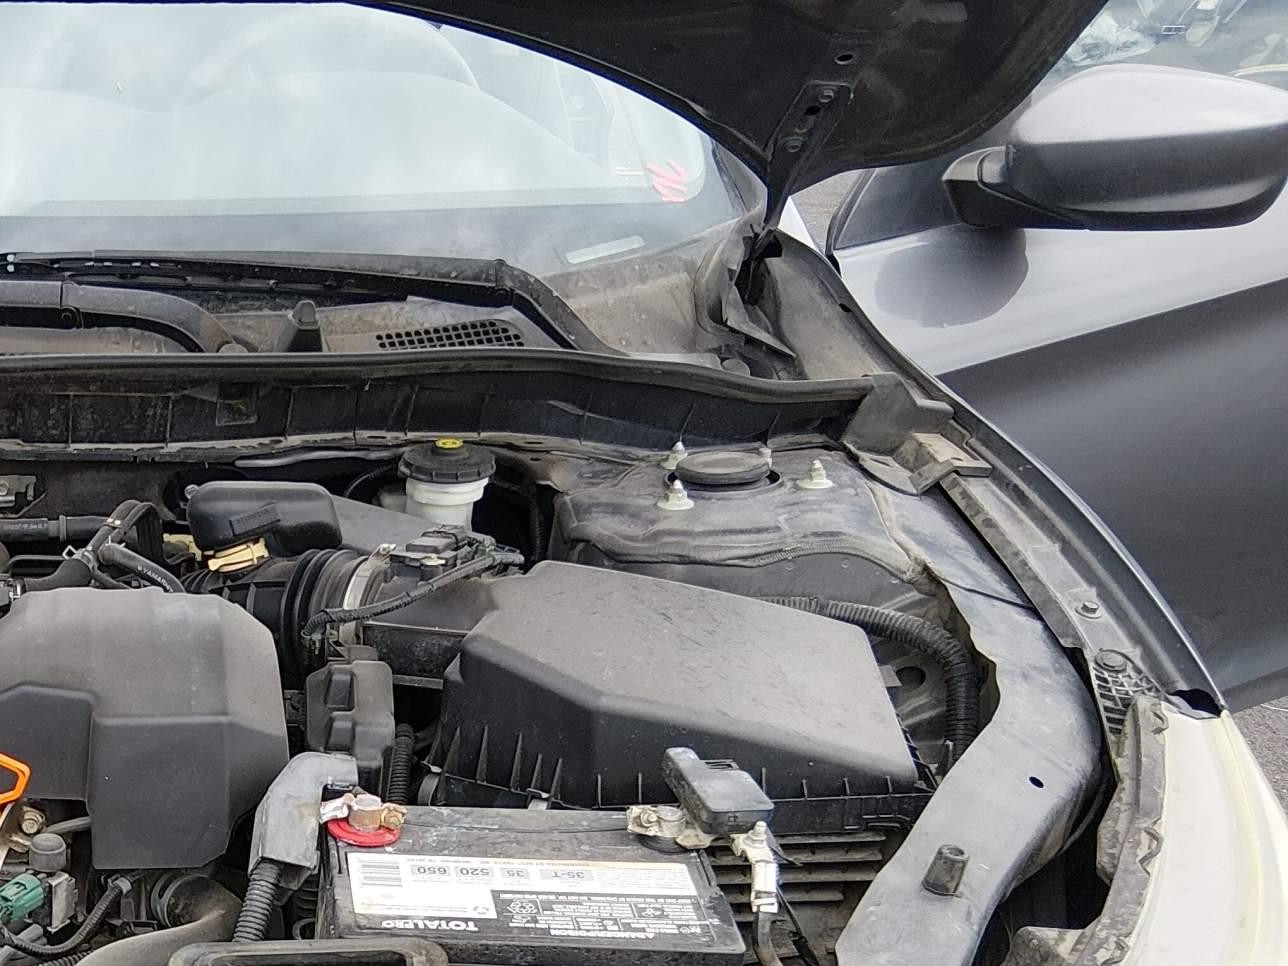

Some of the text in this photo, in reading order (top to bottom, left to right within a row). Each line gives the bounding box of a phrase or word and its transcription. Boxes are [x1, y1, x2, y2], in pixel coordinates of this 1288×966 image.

[416, 865, 585, 879] 35-T 35 520 650
